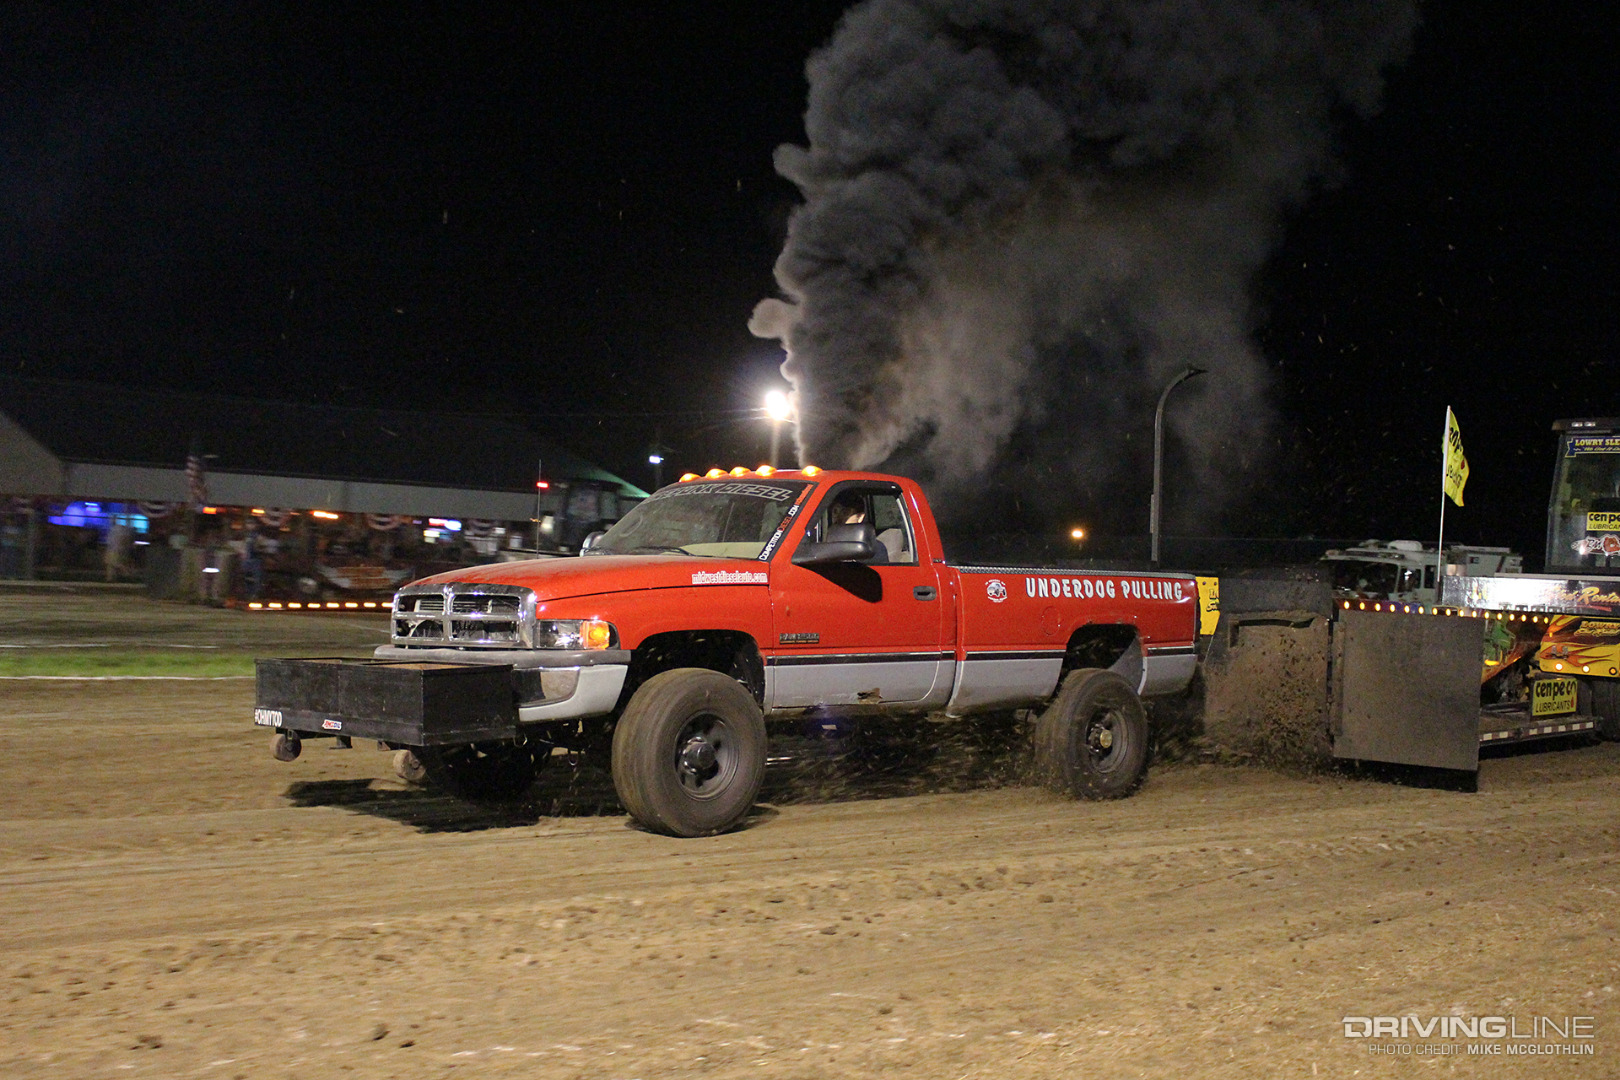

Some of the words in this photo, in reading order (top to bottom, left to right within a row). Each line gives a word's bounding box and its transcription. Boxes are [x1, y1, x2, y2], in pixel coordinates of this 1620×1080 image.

[1575, 439, 1604, 447] LOWRY
[715, 483, 793, 501] DIESEL
[1025, 577, 1116, 600] UNDERDOG
[1120, 580, 1183, 601] PULLING
[1535, 700, 1571, 713] LUBRICANTS
